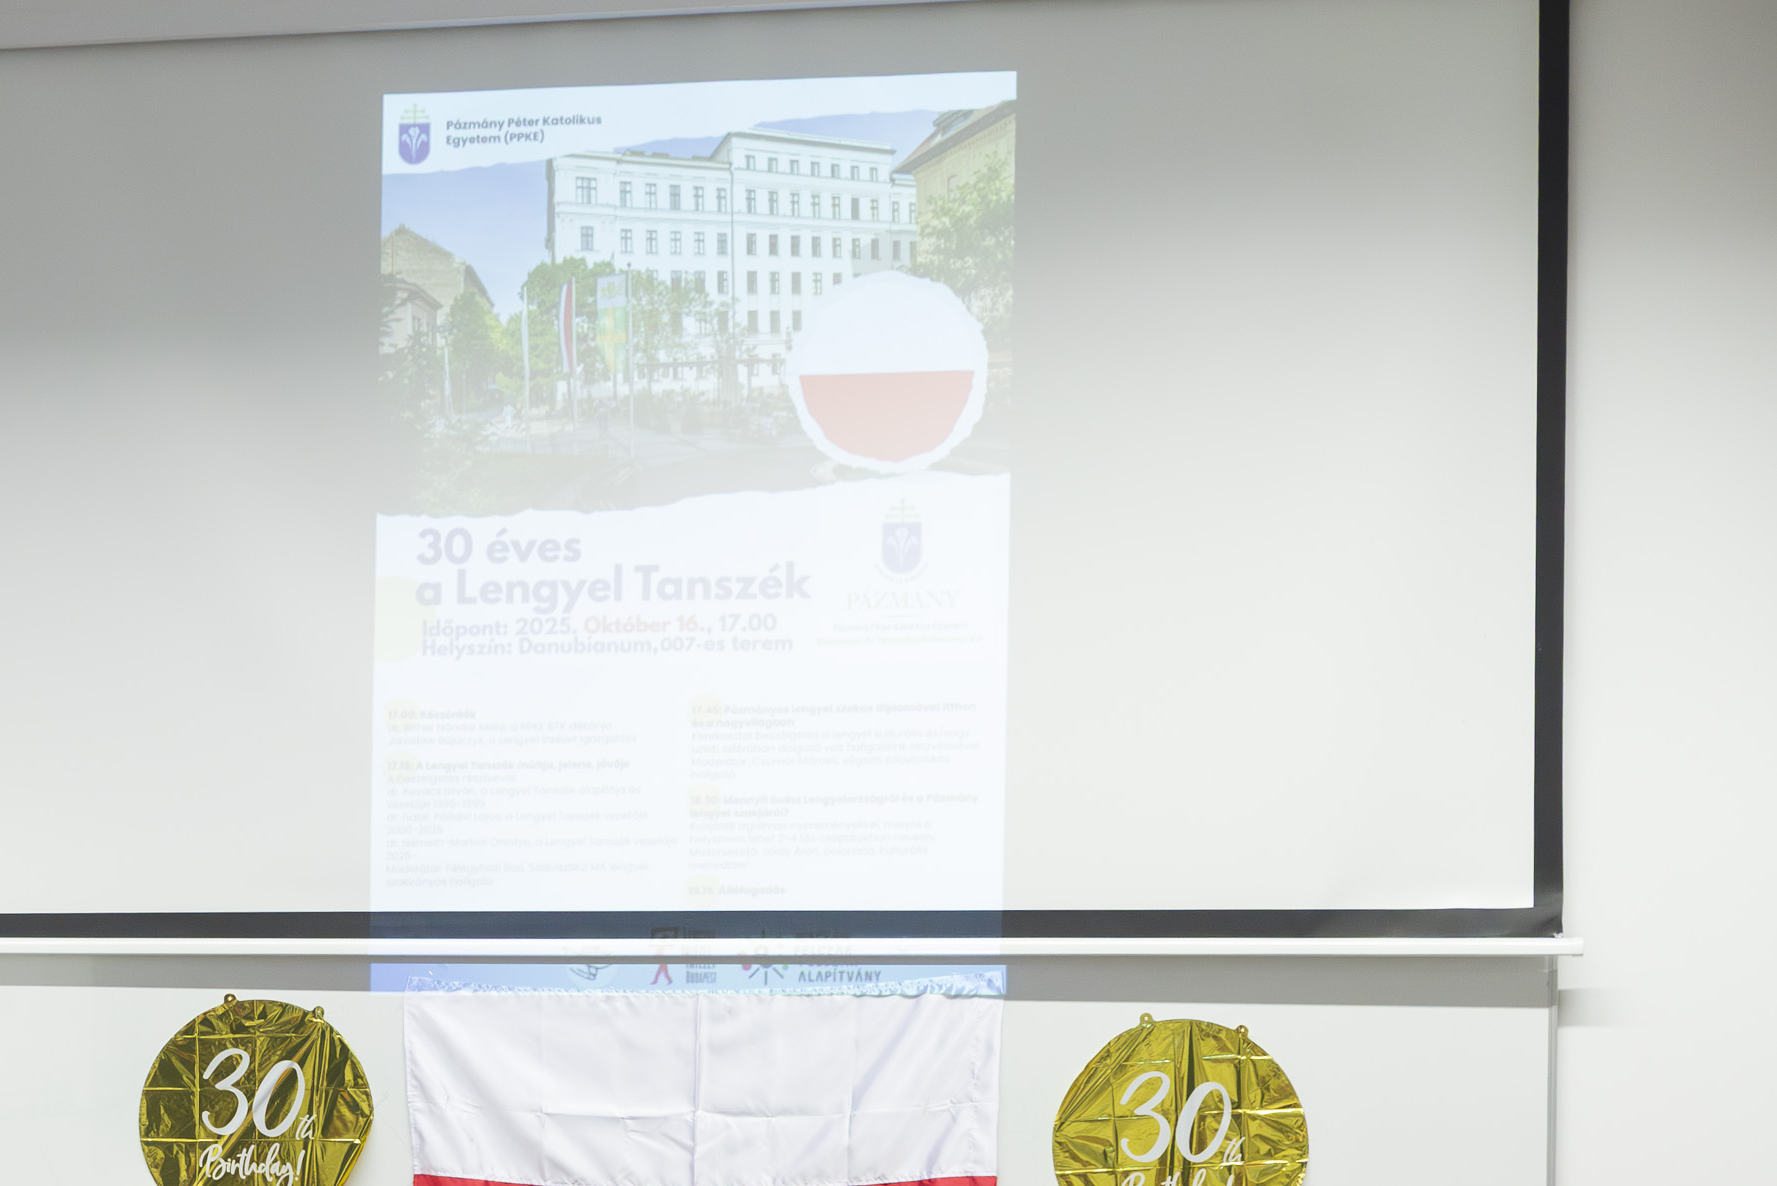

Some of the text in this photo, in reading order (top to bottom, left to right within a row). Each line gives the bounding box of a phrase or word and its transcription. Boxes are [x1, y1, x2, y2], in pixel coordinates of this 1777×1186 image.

[446, 113, 602, 131] Pázmány Péter Katolikus
[446, 129, 545, 148] Egyetem (PPKE)
[416, 527, 582, 565] 30 éves
[415, 561, 812, 615] a Lengyel Tanszék
[421, 618, 508, 640] Időpont:
[515, 617, 578, 637] 2025.
[584, 615, 672, 636] Október
[719, 613, 778, 634] 17.00
[421, 637, 512, 661] Helyszín:
[732, 634, 793, 653] terem
[798, 968, 882, 983] ALAPÍTVÁNY
